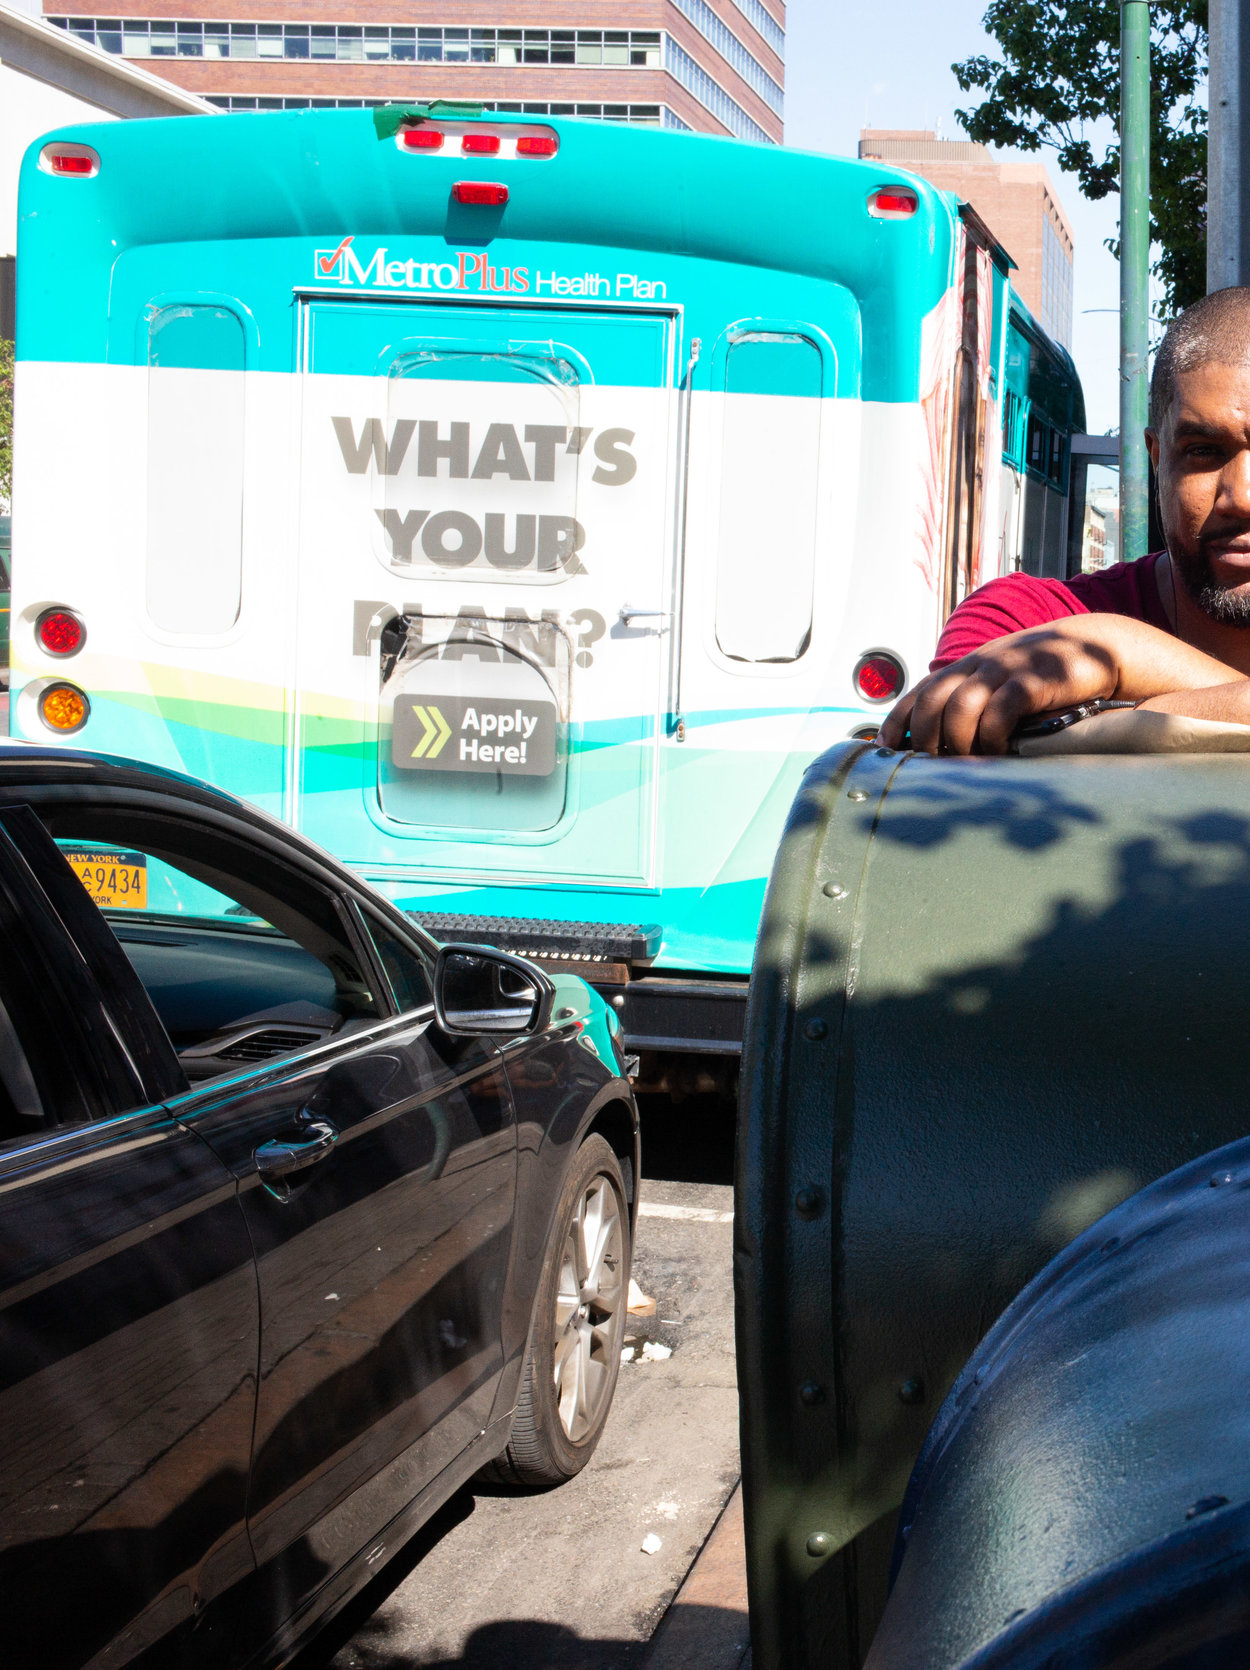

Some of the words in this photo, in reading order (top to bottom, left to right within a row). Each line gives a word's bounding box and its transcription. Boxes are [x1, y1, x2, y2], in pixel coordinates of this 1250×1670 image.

[339, 246, 530, 293] MetroPlus
[536, 270, 610, 296] Health
[616, 273, 666, 299] Plan
[331, 416, 638, 487] WHAT'S
[374, 509, 589, 575] YOUR
[353, 600, 607, 669] PLAN?
[461, 707, 538, 739] Apply
[458, 739, 527, 764] Here!
[92, 854, 120, 864] YORK
